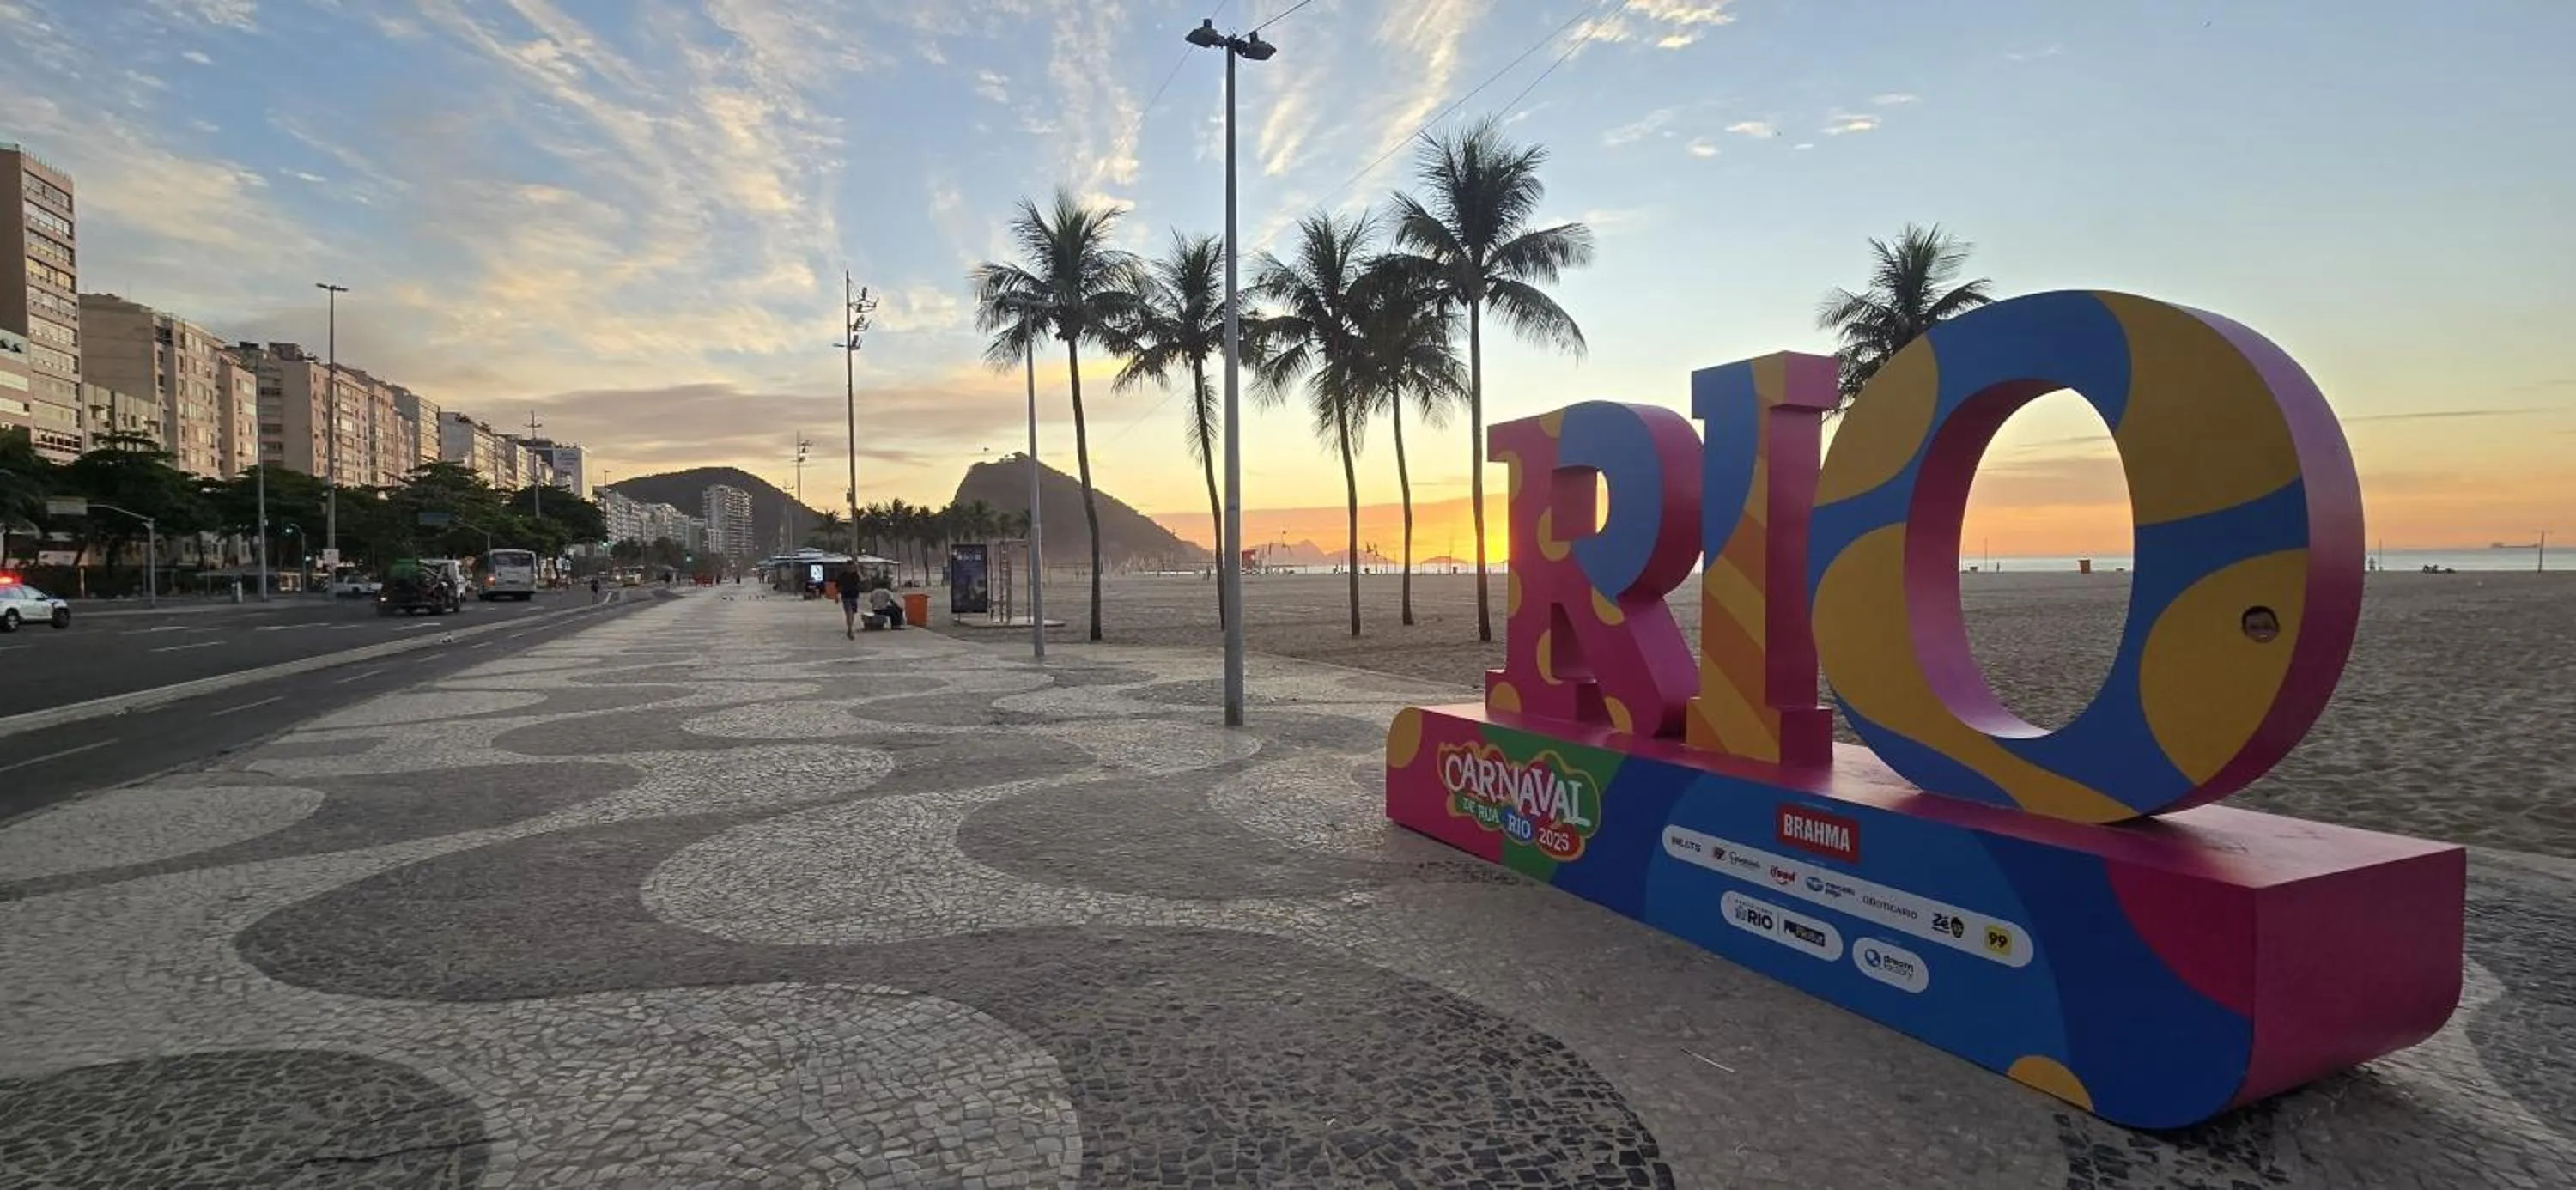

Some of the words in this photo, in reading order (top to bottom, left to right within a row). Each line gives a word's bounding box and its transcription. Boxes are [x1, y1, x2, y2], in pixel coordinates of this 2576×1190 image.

[1485, 289, 2365, 824] RIO
[1445, 752, 1592, 827] CARNAVAL
[1462, 797, 1475, 812] DE
[1478, 804, 1500, 823] RUA
[1507, 813, 1531, 839] RIO
[1538, 828, 1570, 851] 2025
[1783, 813, 1850, 853] BRAHMA
[1747, 909, 1773, 930] RIO
[1988, 932, 2008, 948] 99
